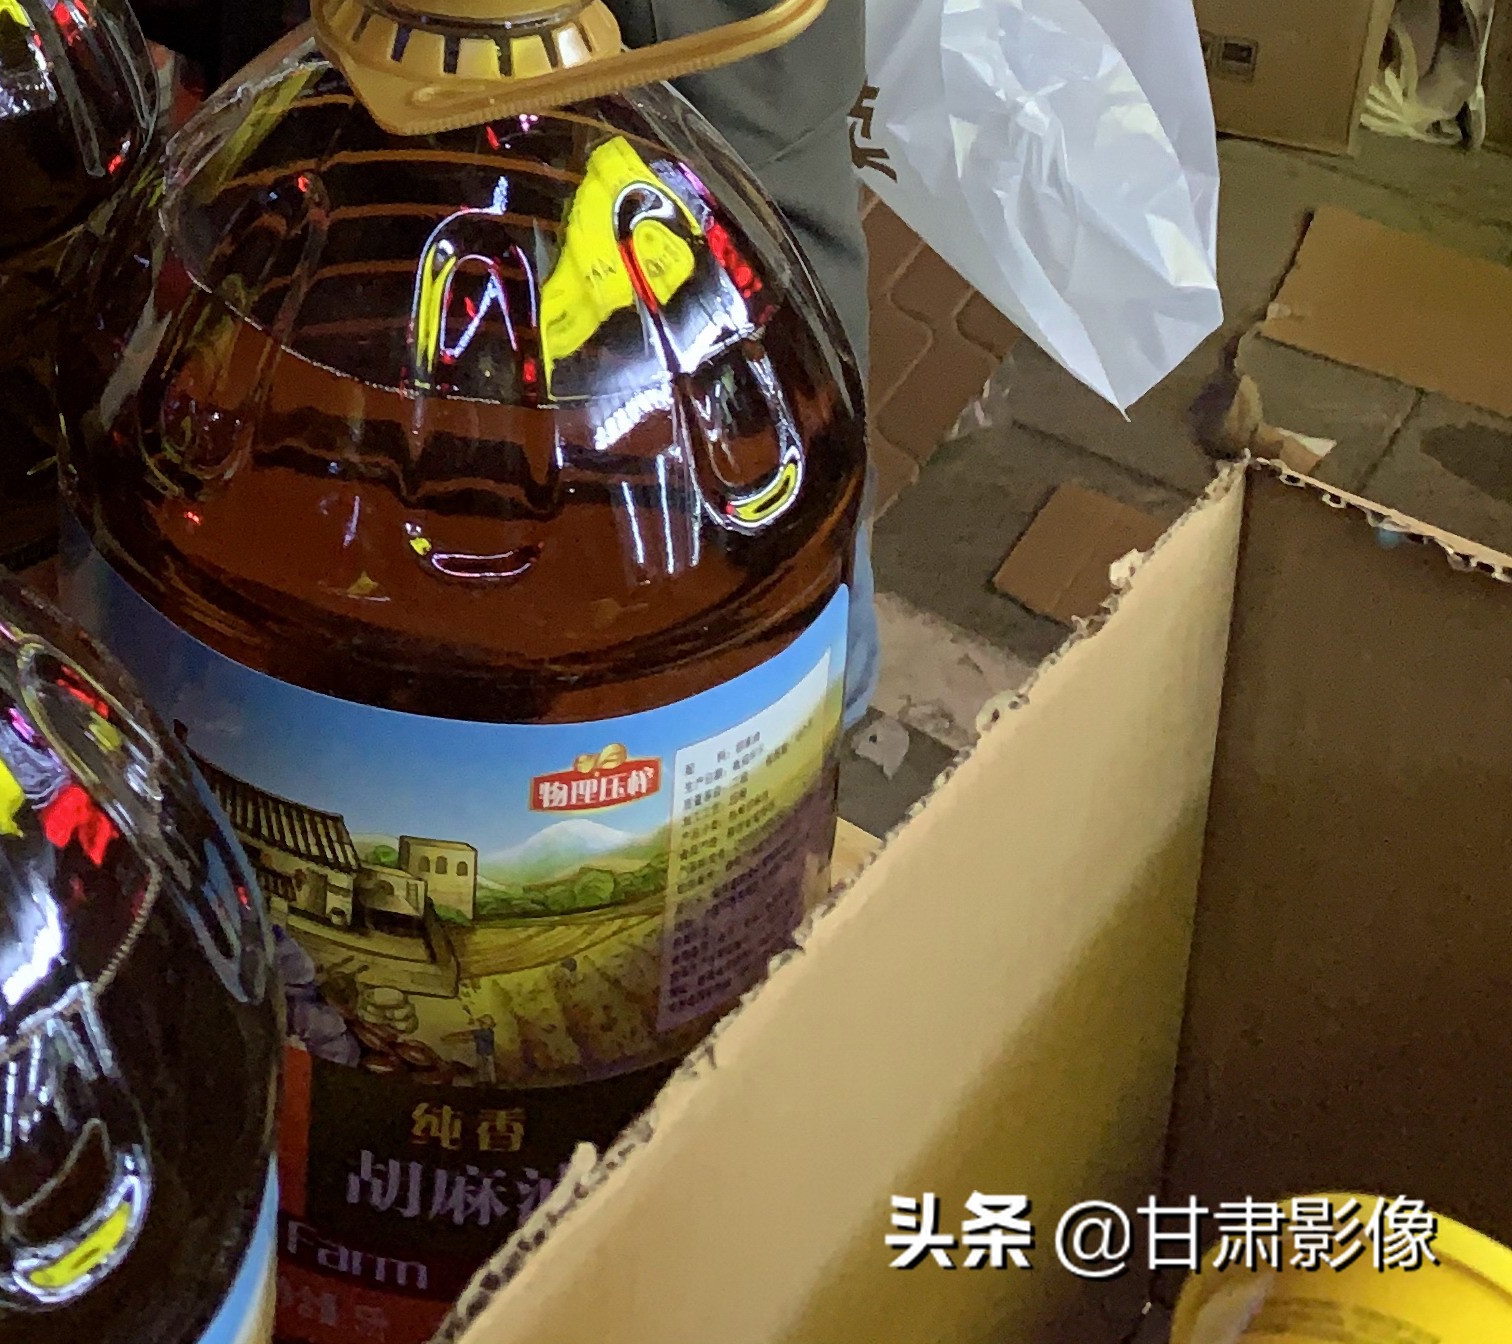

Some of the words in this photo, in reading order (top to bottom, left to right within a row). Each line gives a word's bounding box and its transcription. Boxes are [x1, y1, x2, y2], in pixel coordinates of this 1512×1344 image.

[539, 765, 656, 809] 物理压榨
[411, 1101, 525, 1152] 纯香
[287, 1219, 429, 1290] Farm
